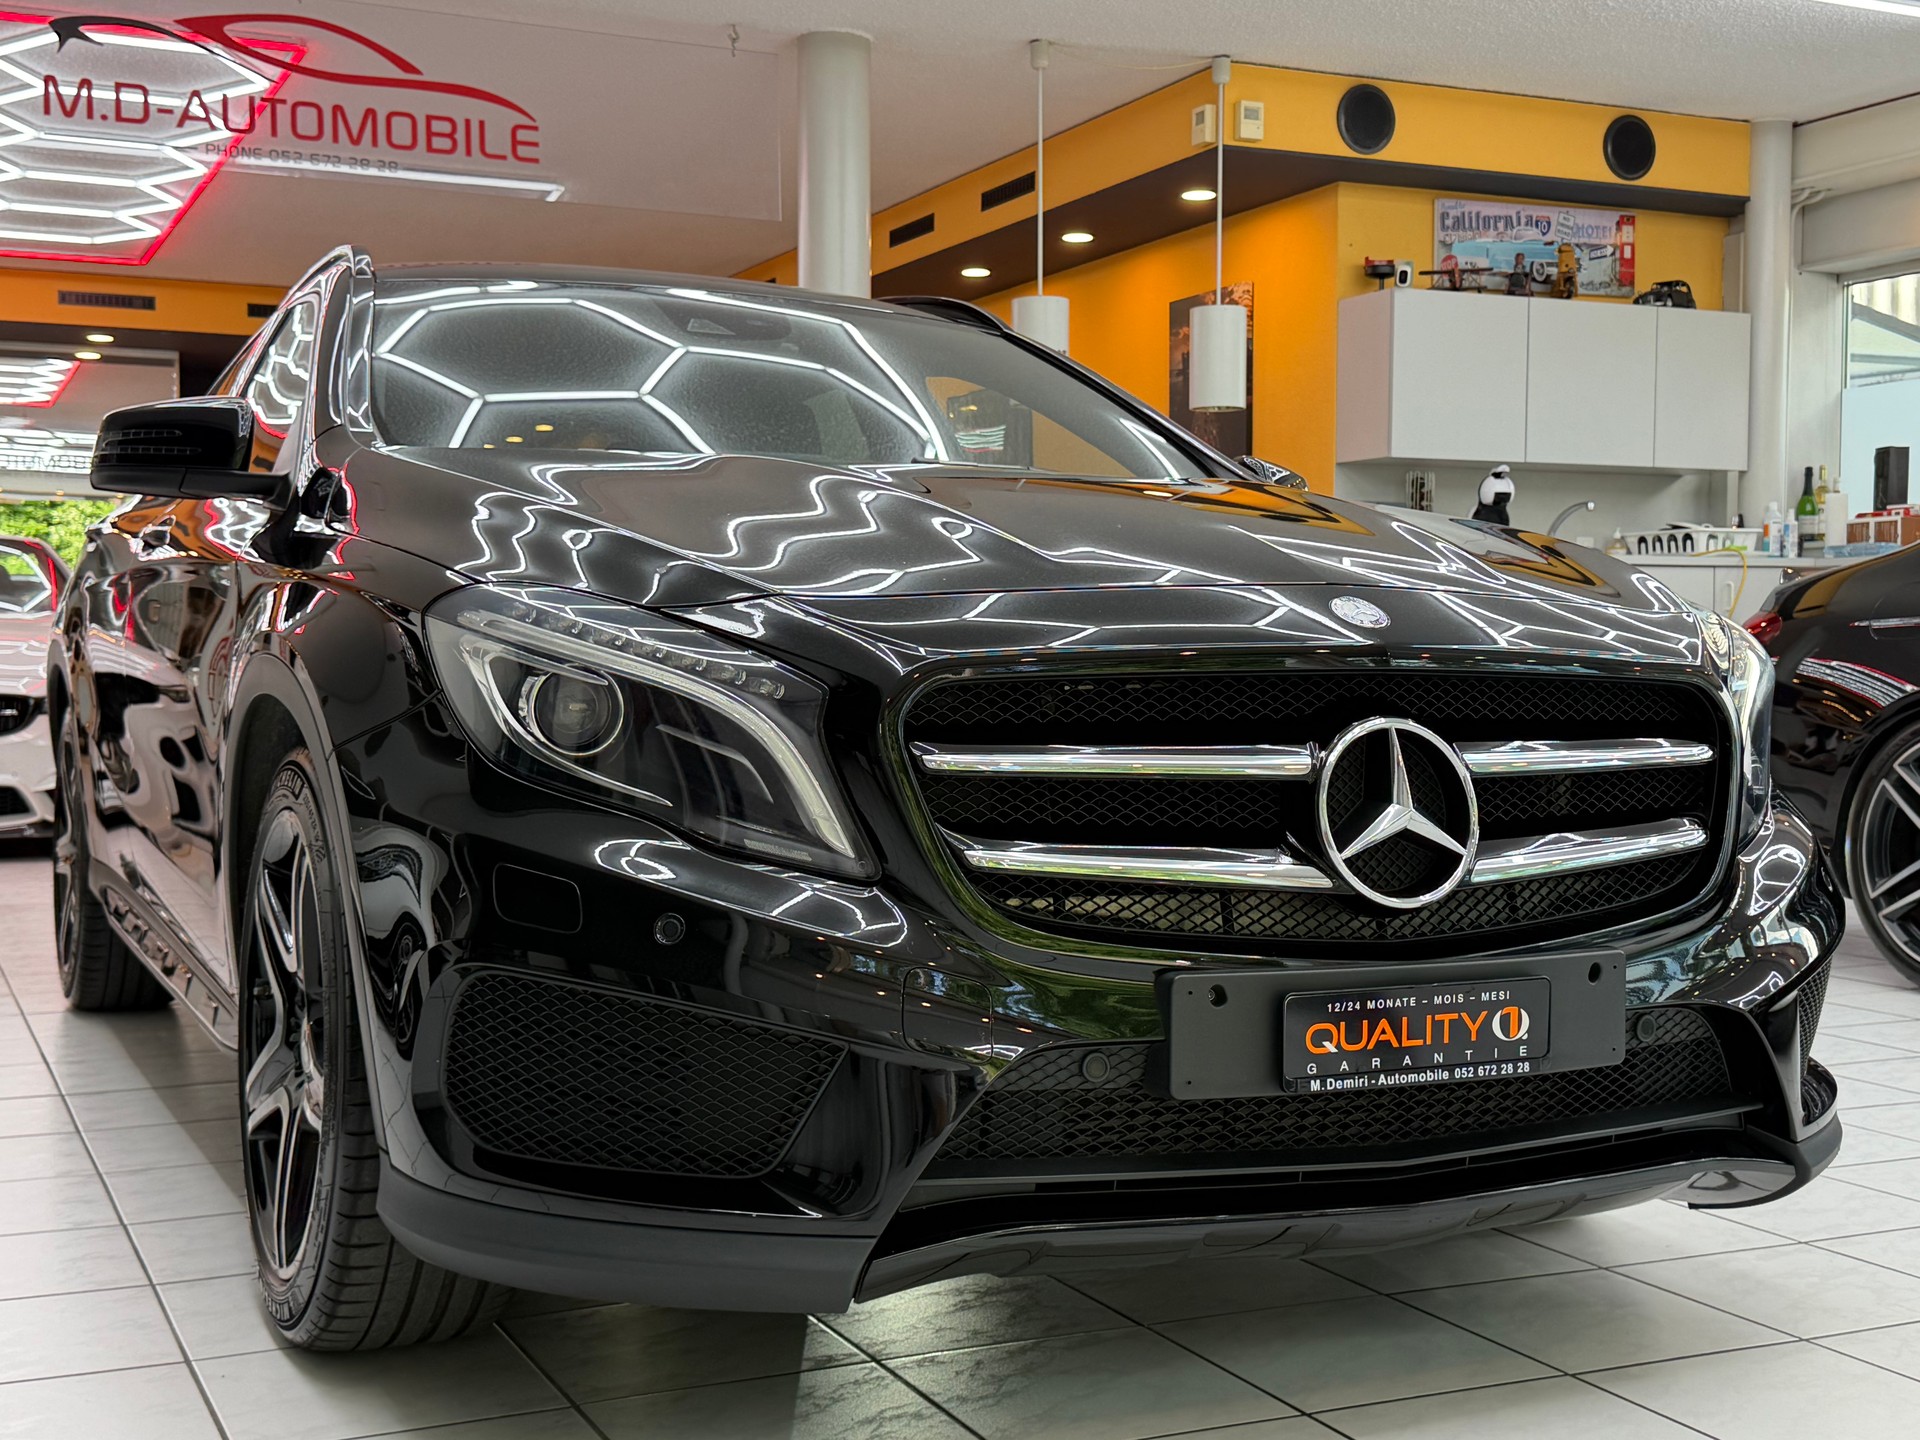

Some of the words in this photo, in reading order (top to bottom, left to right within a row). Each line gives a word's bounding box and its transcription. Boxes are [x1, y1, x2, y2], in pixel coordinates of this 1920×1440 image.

[43, 75, 540, 164] M.D-AUTOMOBILE
[205, 143, 263, 160] PHONE
[269, 148, 303, 163] 052
[349, 157, 371, 171] 28
[377, 159, 399, 173] 28
[1440, 209, 1535, 233] California
[1537, 221, 1549, 233] 10
[1327, 1001, 1361, 1013] 12/24
[1366, 996, 1417, 1010] MONATE
[1433, 993, 1464, 1005] MOIS
[1481, 990, 1511, 1002] MESI
[1305, 1010, 1489, 1055] QUALITY
[1306, 1045, 1528, 1075] GARANTIE
[1454, 1067, 1474, 1079] 052
[1477, 1064, 1497, 1077] 672
[1500, 1063, 1514, 1075] 28
[1517, 1061, 1530, 1073] 28
